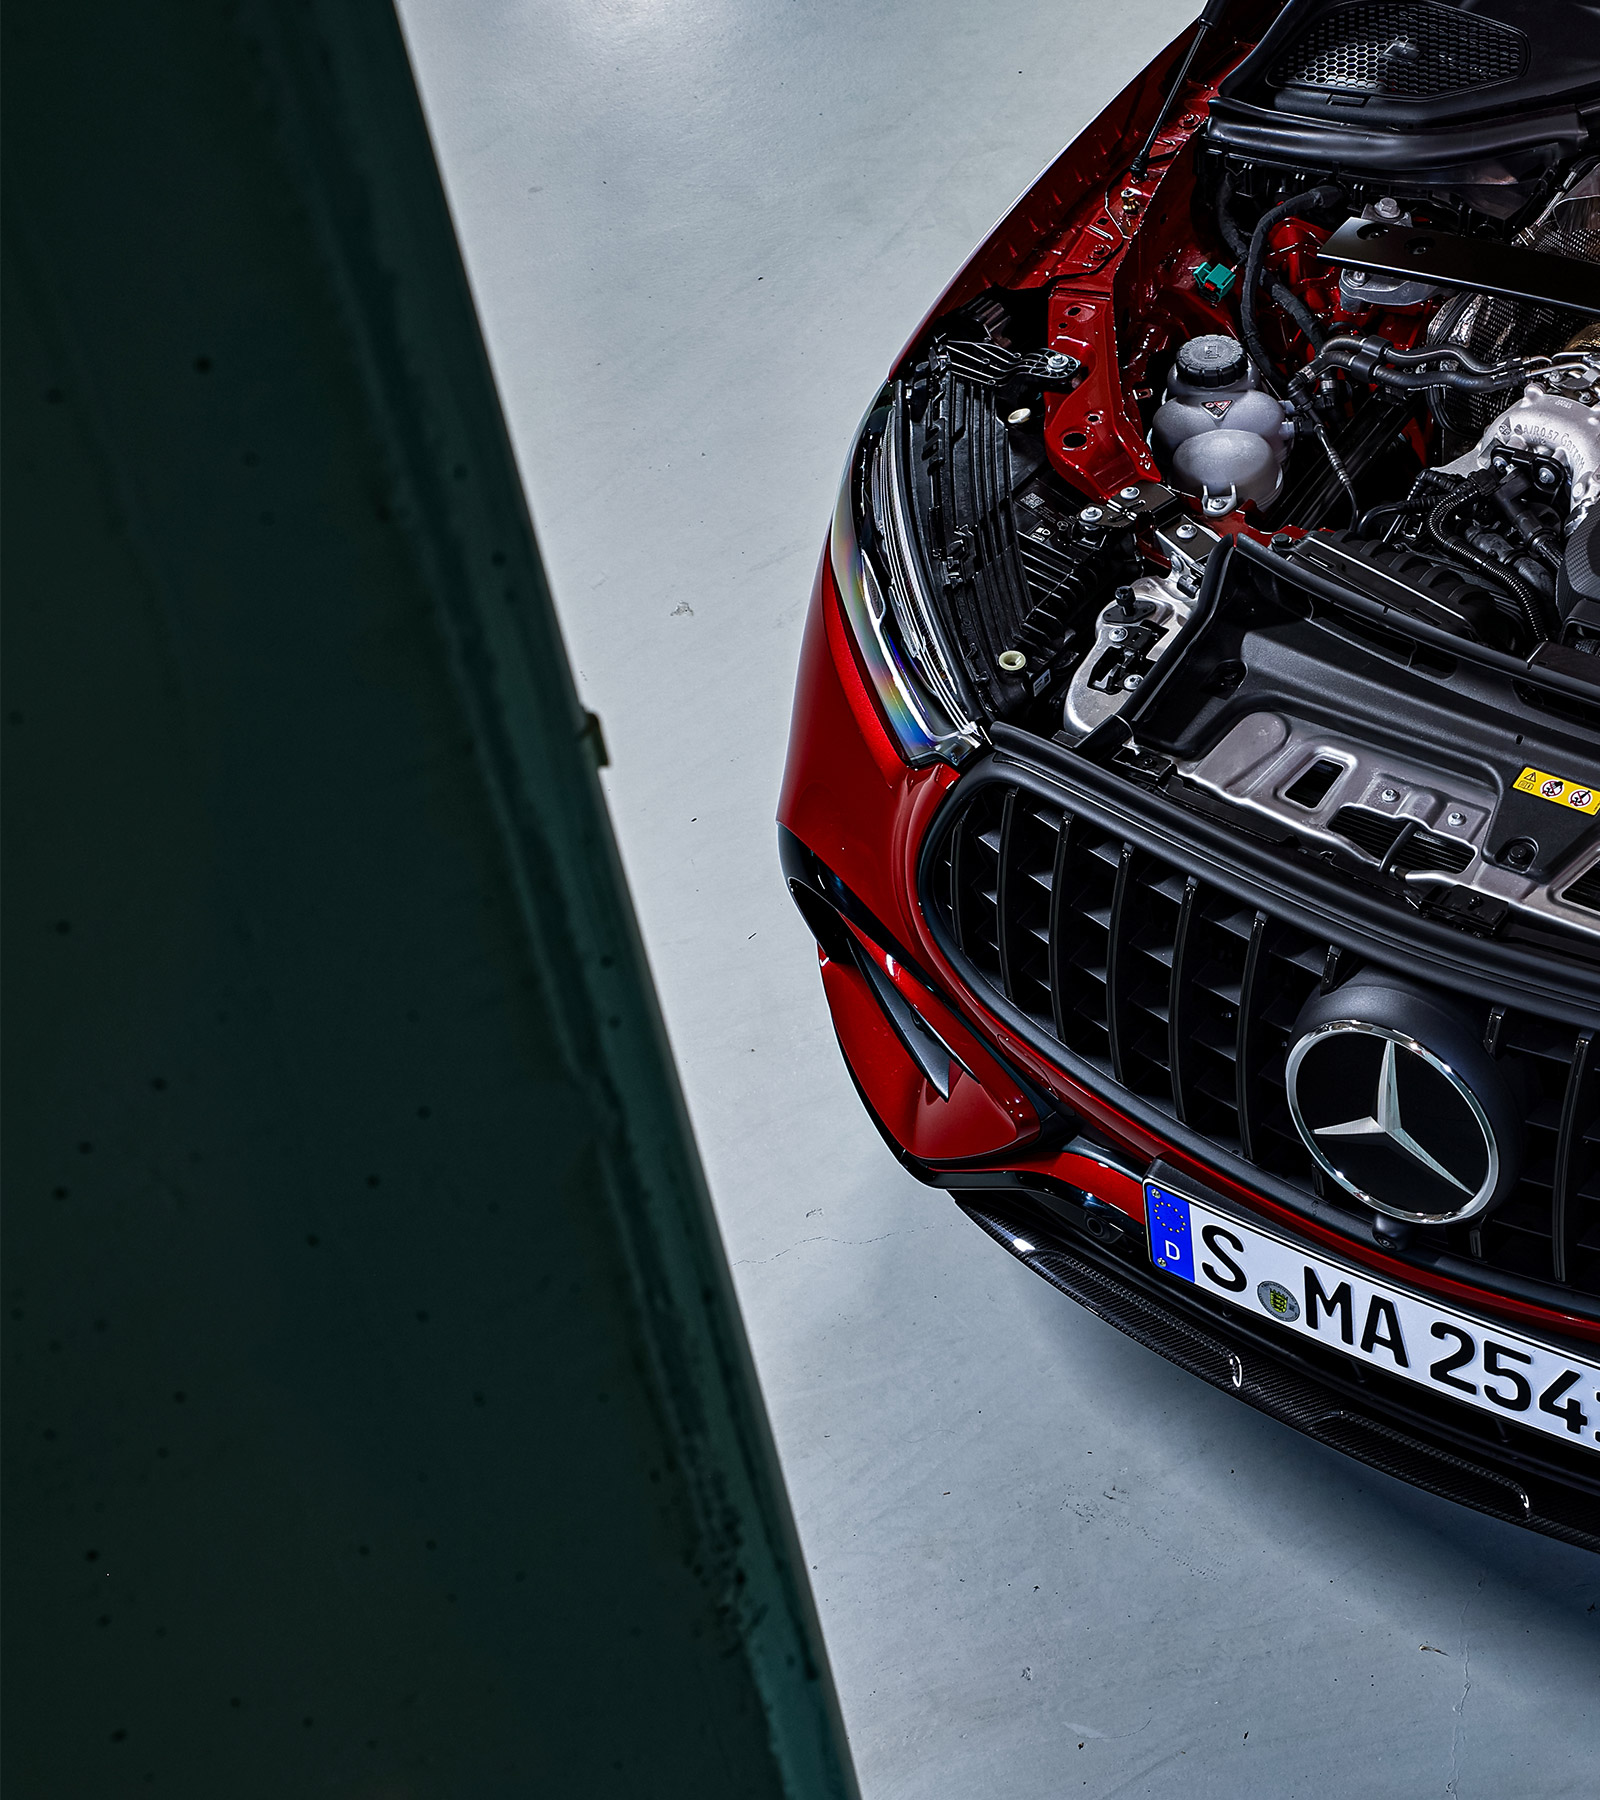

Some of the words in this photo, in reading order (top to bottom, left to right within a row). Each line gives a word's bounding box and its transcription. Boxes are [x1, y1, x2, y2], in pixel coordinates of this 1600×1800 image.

[1165, 1239, 1181, 1261] D
[1201, 1223, 1248, 1293] S
[1303, 1265, 1409, 1368] MA
